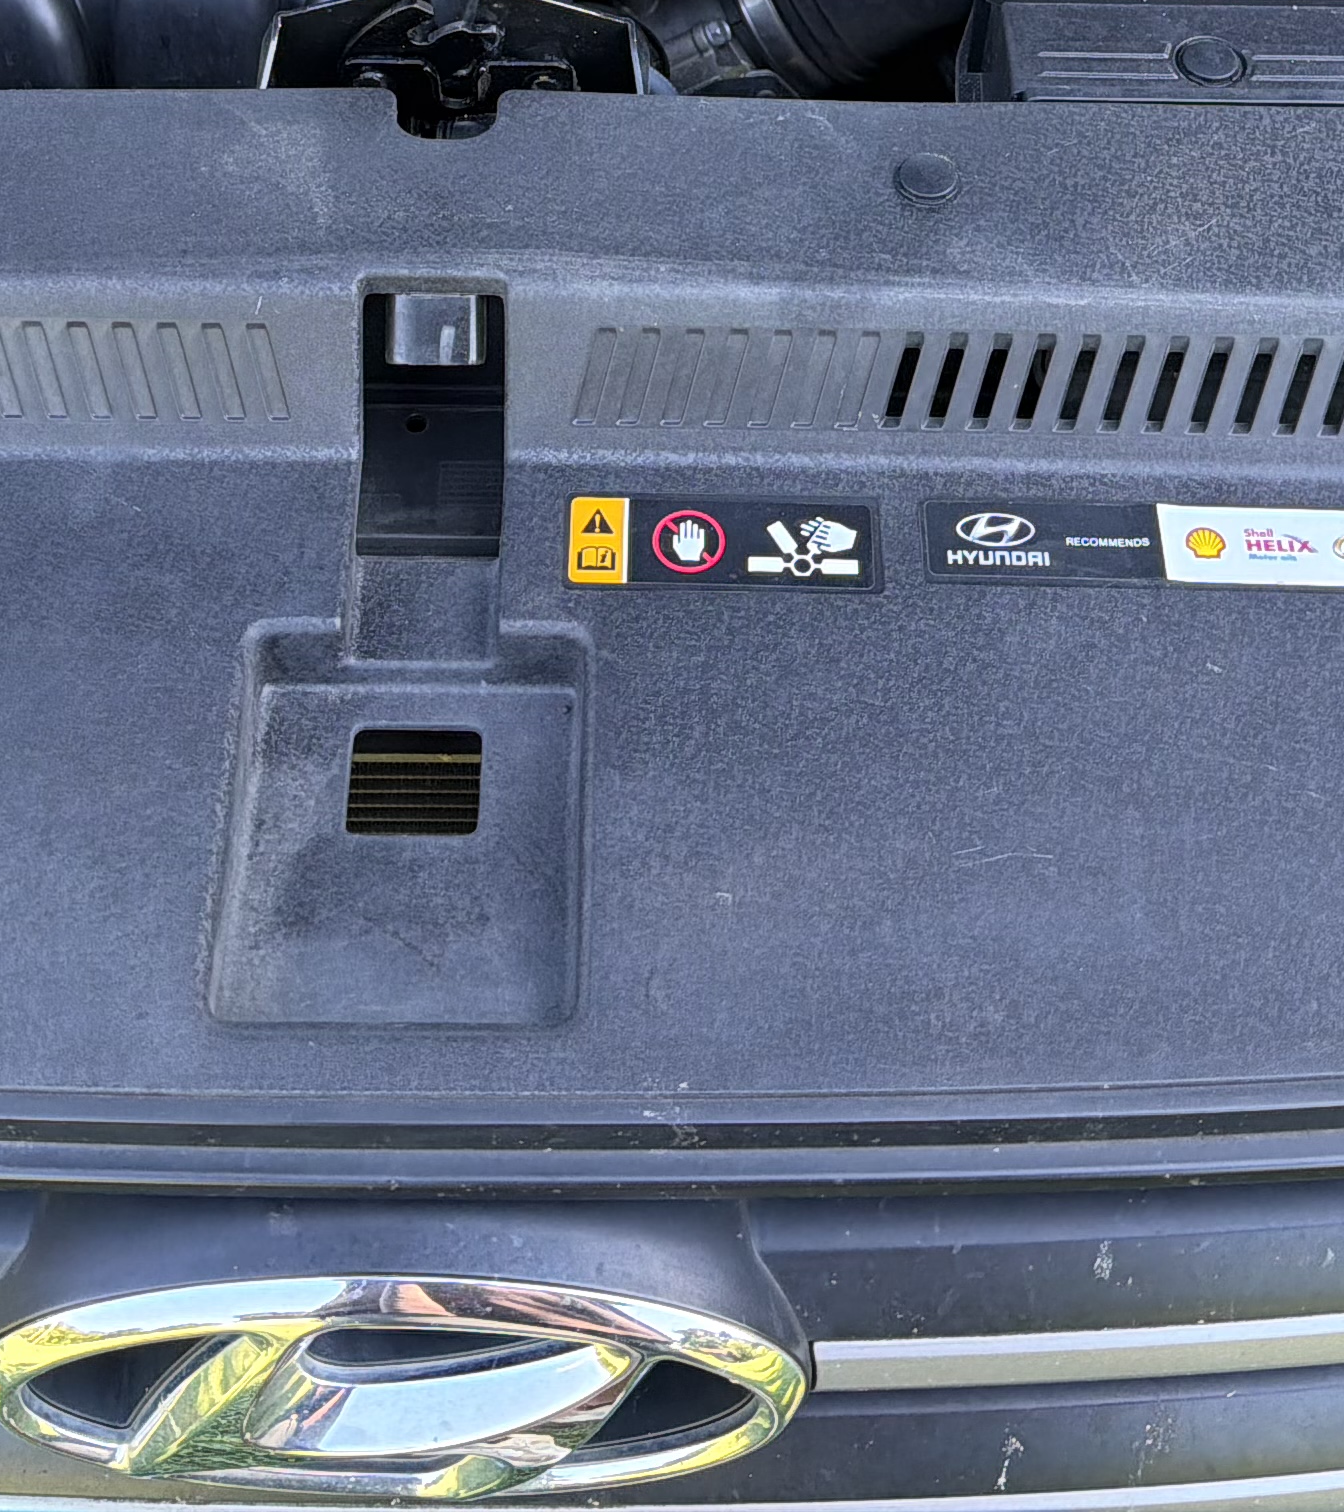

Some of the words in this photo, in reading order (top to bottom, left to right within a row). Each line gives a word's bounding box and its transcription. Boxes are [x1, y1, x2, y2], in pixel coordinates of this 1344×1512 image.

[1243, 528, 1274, 538] Shell
[946, 549, 1051, 567] HYUNDAI
[1065, 536, 1150, 548] RECOMMENDS
[1245, 538, 1317, 553] HELIX
